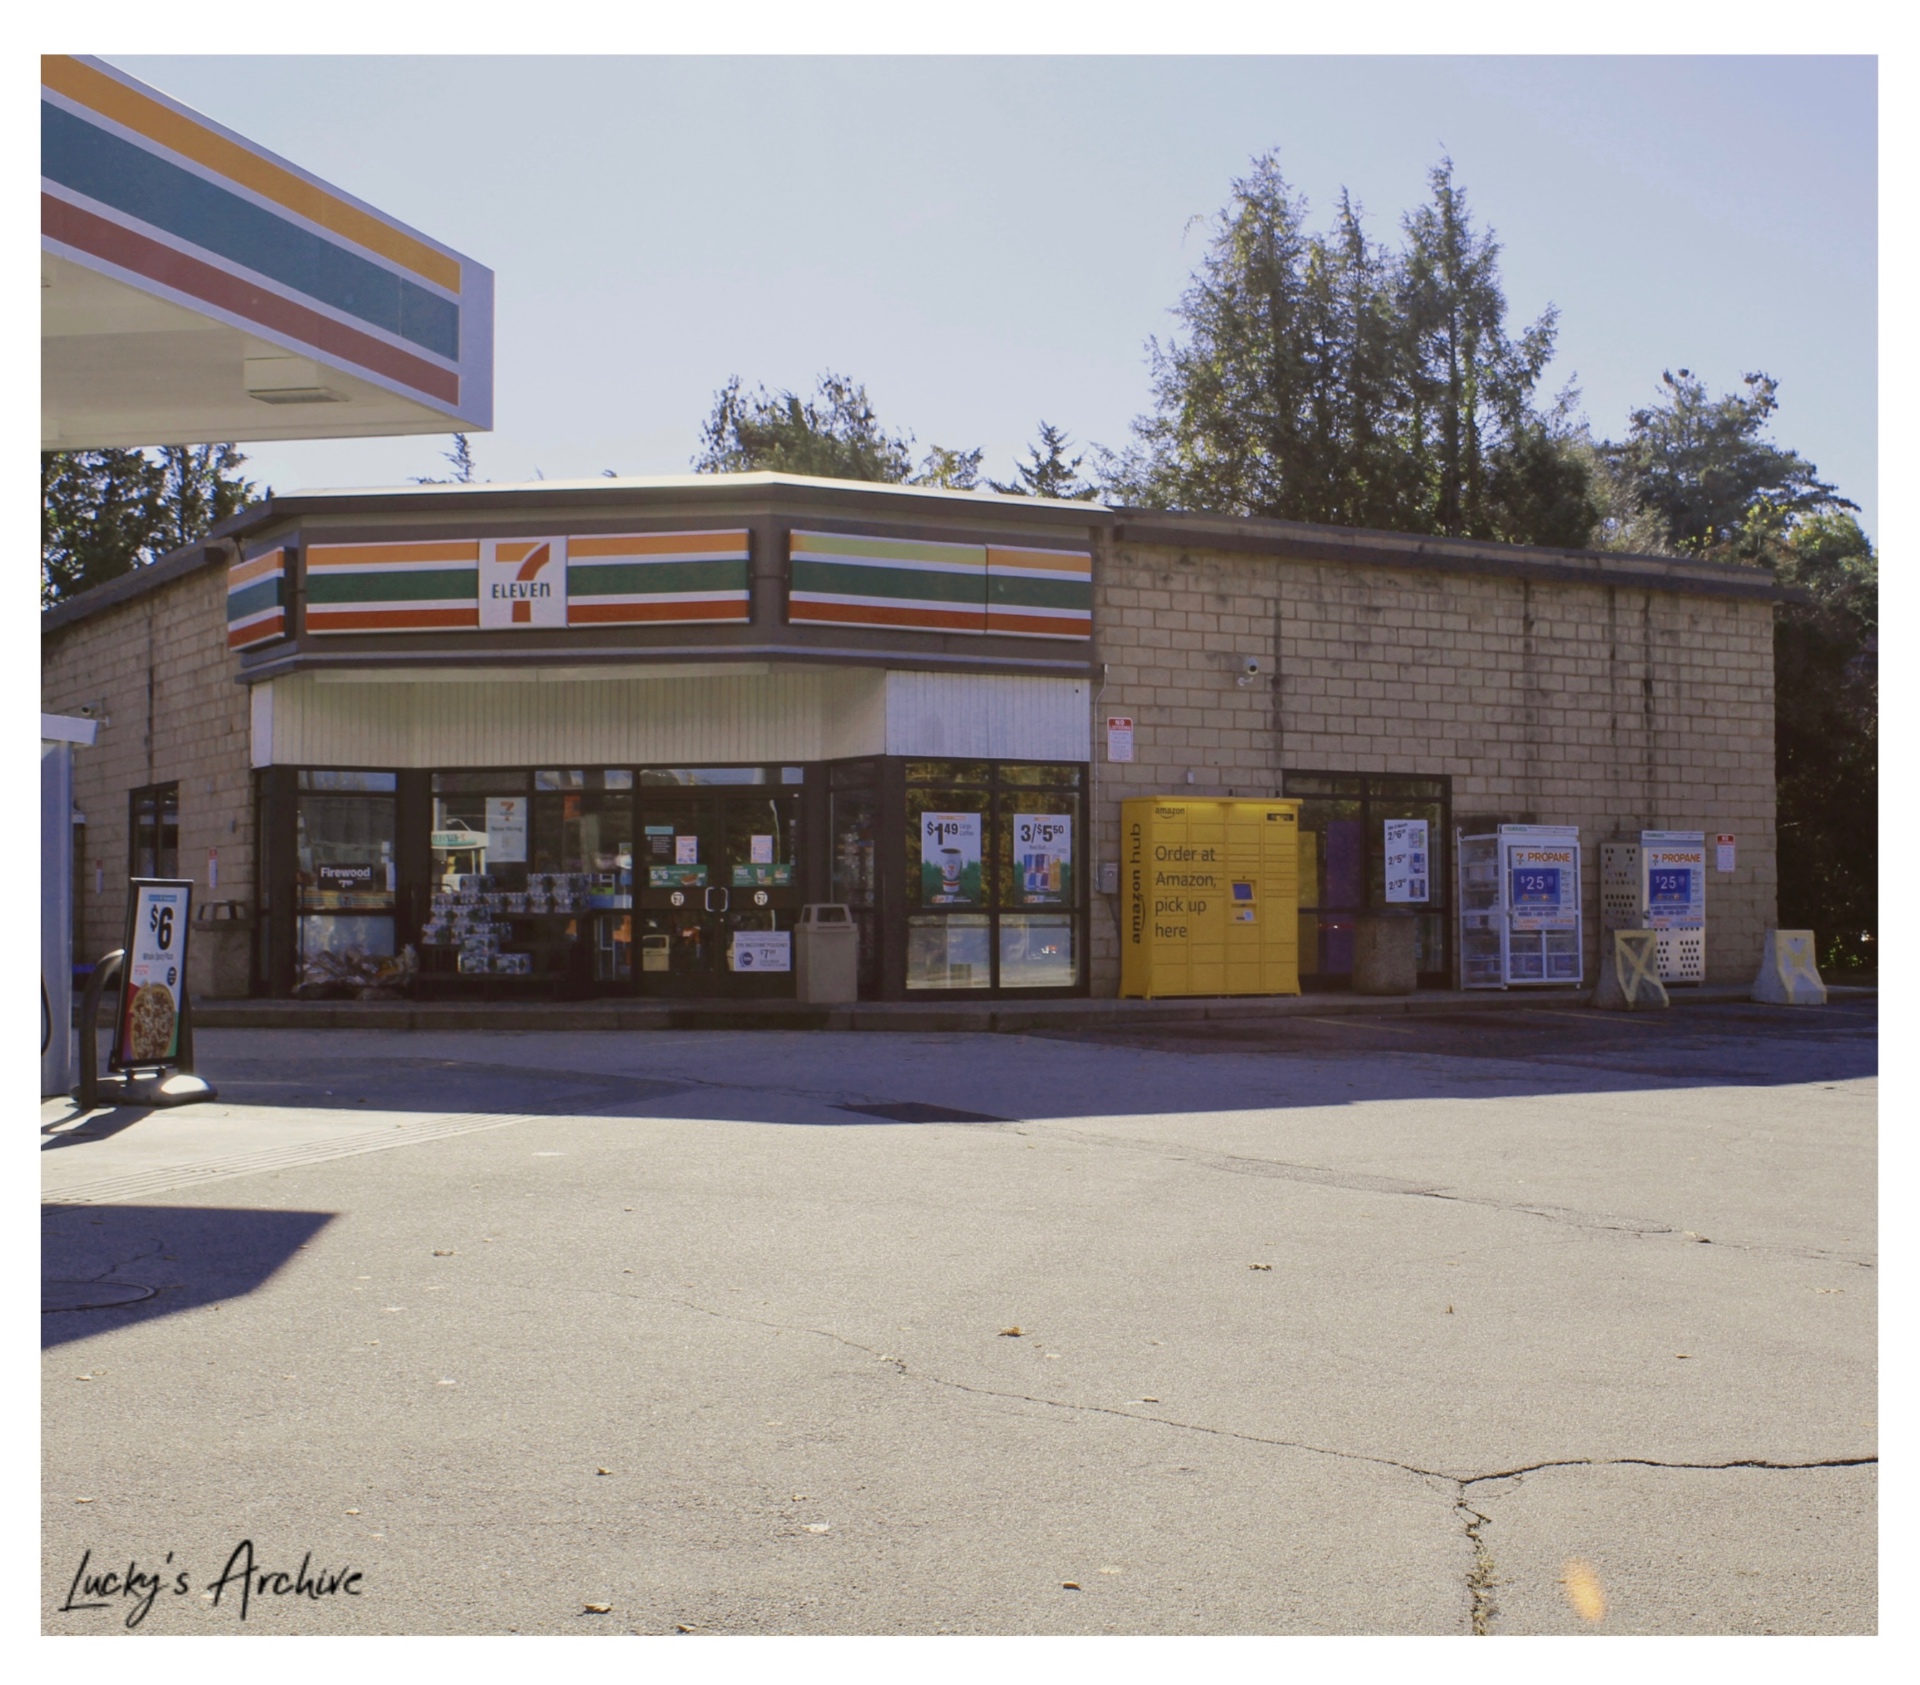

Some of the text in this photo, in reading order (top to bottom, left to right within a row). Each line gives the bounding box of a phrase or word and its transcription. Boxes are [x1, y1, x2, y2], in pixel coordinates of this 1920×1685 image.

[495, 542, 550, 623] 7
[1154, 807, 1185, 816] amazon
[1155, 845, 1216, 861] Order at
[1527, 852, 1570, 863] PROPANE
[1661, 853, 1701, 863] PROPANE
[320, 866, 371, 878] Firewood
[1130, 823, 1142, 944] amazon hub
[1155, 872, 1217, 889] Amazon,
[1155, 896, 1207, 916] pick up
[150, 904, 174, 951] $6
[1155, 922, 1188, 938] here
